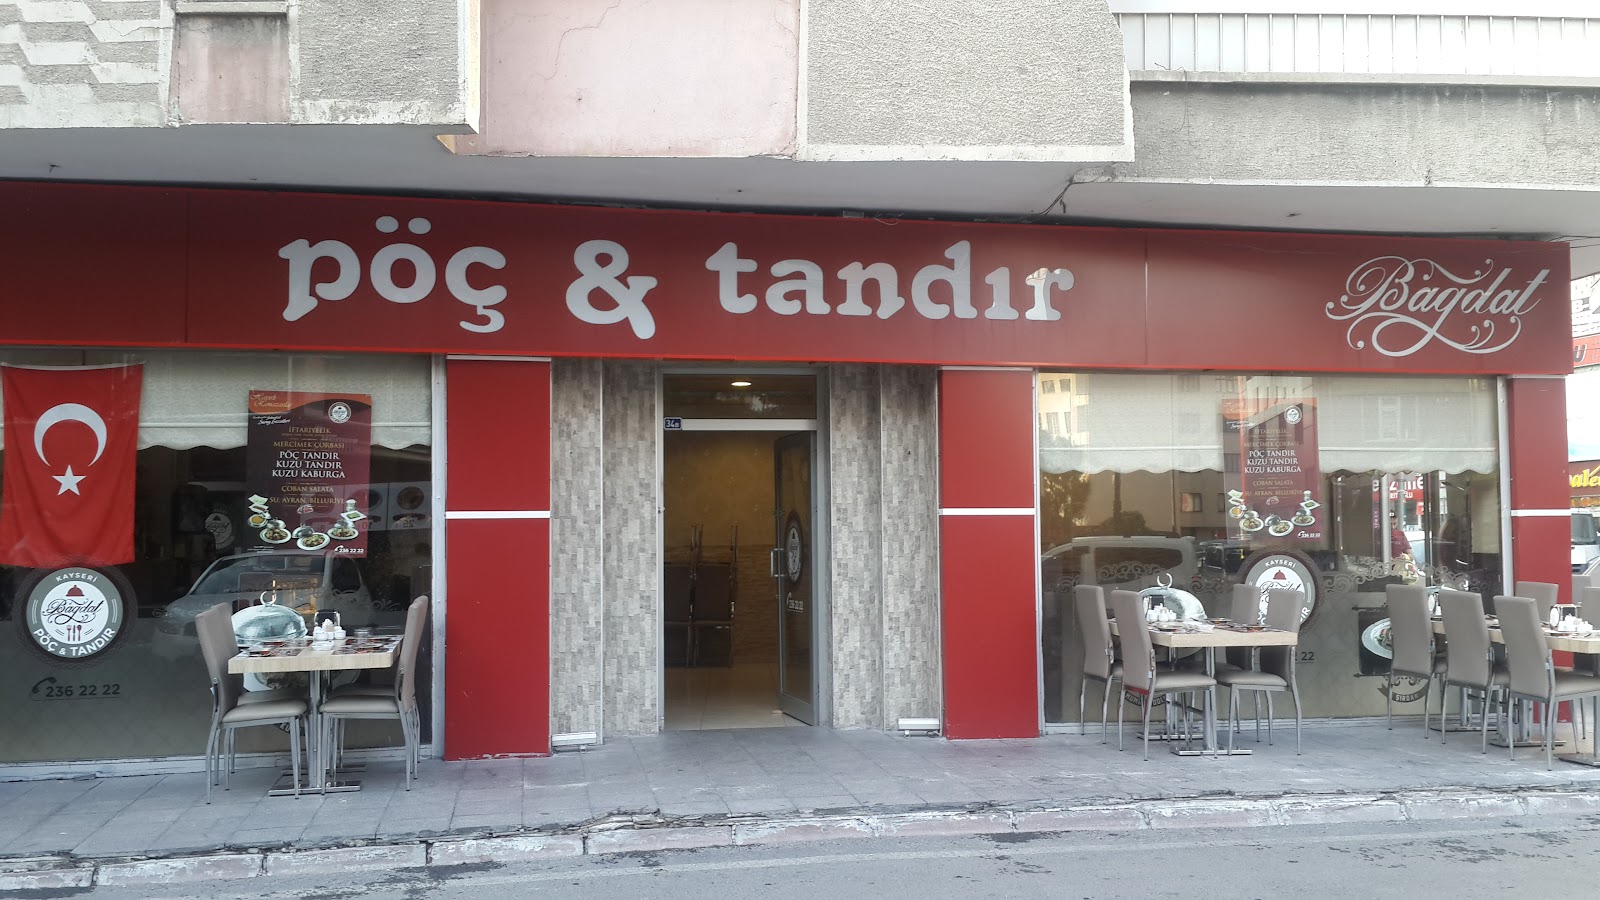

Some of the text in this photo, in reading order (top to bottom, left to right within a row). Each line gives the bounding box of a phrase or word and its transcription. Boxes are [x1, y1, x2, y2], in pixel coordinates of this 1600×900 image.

[278, 215, 1075, 340] pöç & tandır
[280, 450, 339, 460] PÖÇ TANDIR
[1267, 449, 1295, 457] TANDIR
[276, 461, 342, 469] KUZU TANDIR
[1247, 458, 1268, 466] KUZU
[272, 469, 346, 478] KUZU KABURGA
[281, 485, 334, 493] ÇOBAN SALATA
[1265, 559, 1297, 569] KAYSERİ
[55, 572, 98, 583] KAYSERİ
[33, 627, 116, 657] PÖÇ & TANDIR
[1301, 651, 1315, 661] 22
[46, 684, 120, 697] 236 22 22
